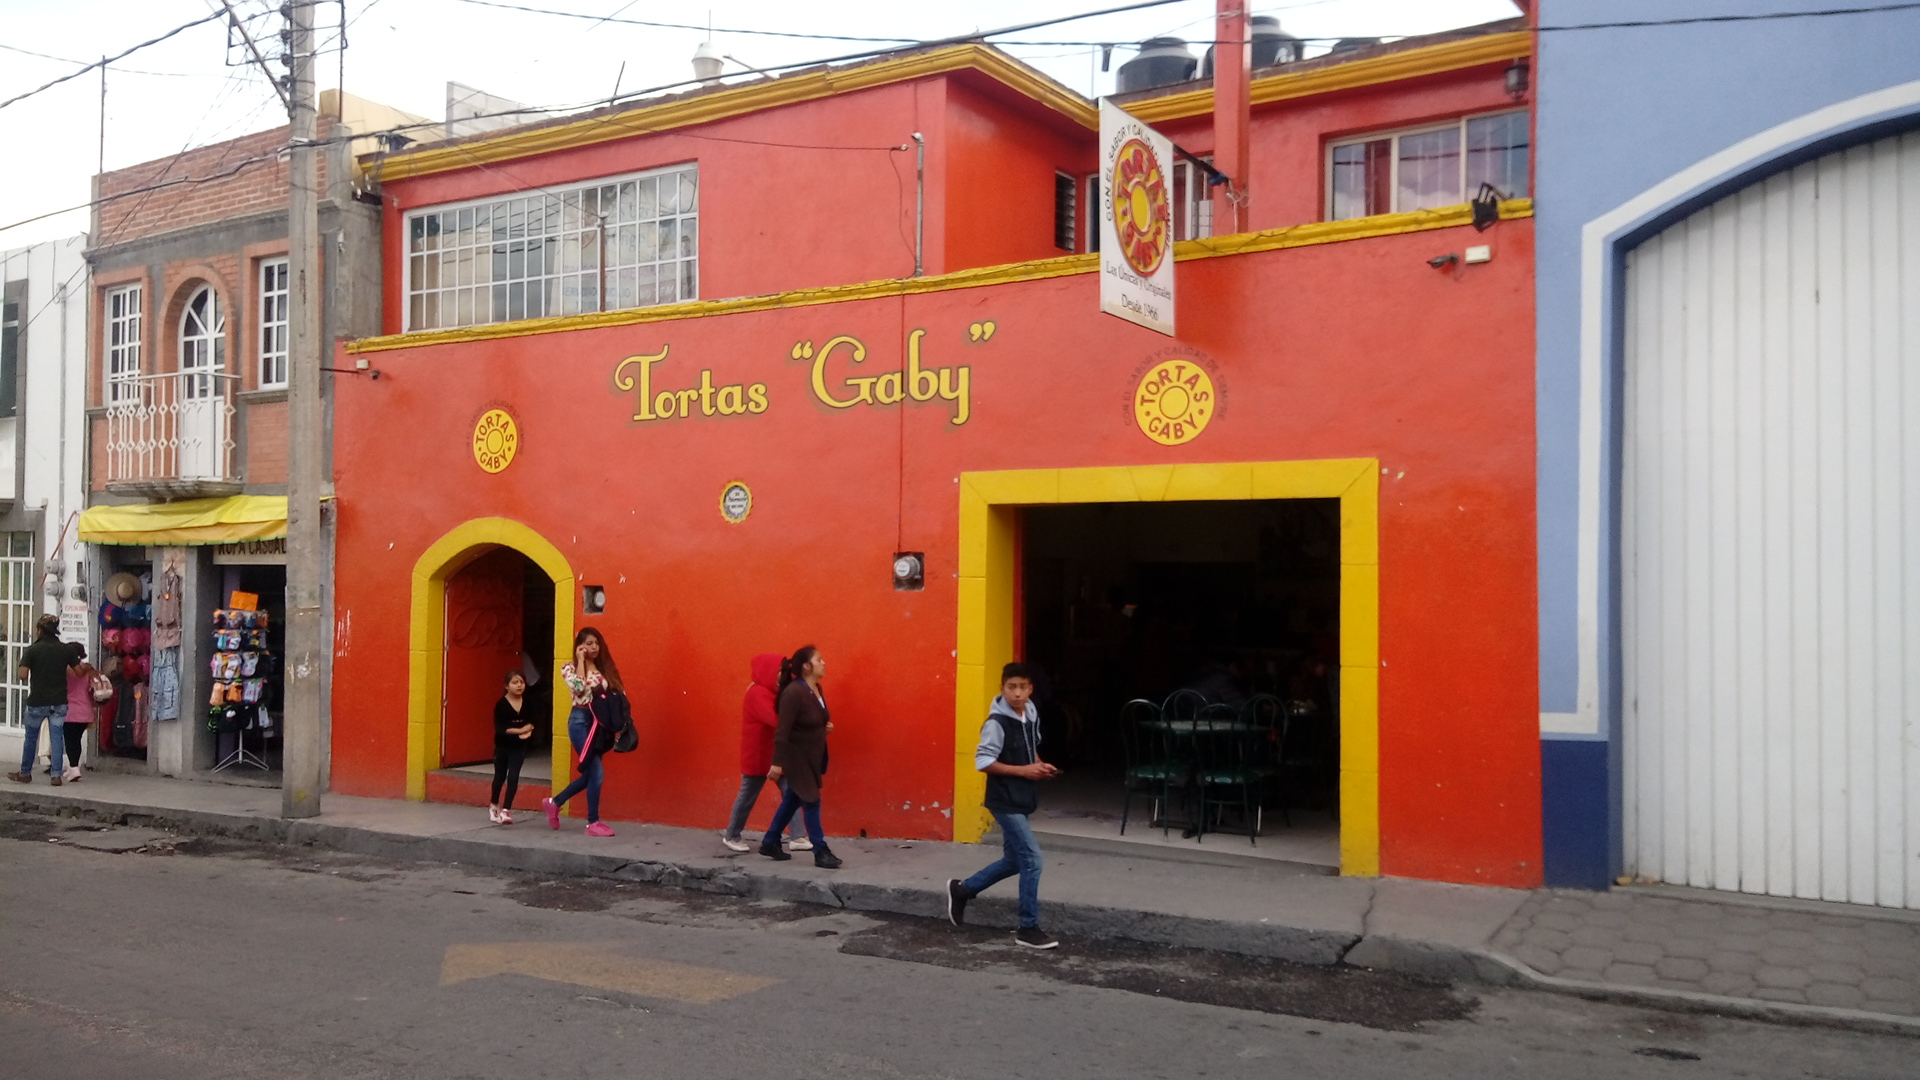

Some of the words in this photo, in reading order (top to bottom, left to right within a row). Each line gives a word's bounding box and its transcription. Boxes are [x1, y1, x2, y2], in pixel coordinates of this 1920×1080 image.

[1109, 126, 1128, 160] SABOR
[1105, 166, 1113, 182] EL
[1104, 186, 1113, 222] CON
[1106, 260, 1117, 278] Las
[1121, 293, 1142, 314] Desde
[1127, 354, 1154, 386] SABOR
[1163, 346, 1208, 362] CALIDAD
[1205, 359, 1219, 373] DE
[614, 344, 769, 422] Tortas
[1140, 365, 1210, 407] TORTAS
[475, 413, 515, 445] TORTAS
[1148, 412, 1199, 440] GABY
[479, 448, 508, 469] GABY
[248, 538, 287, 555] CASUAL
